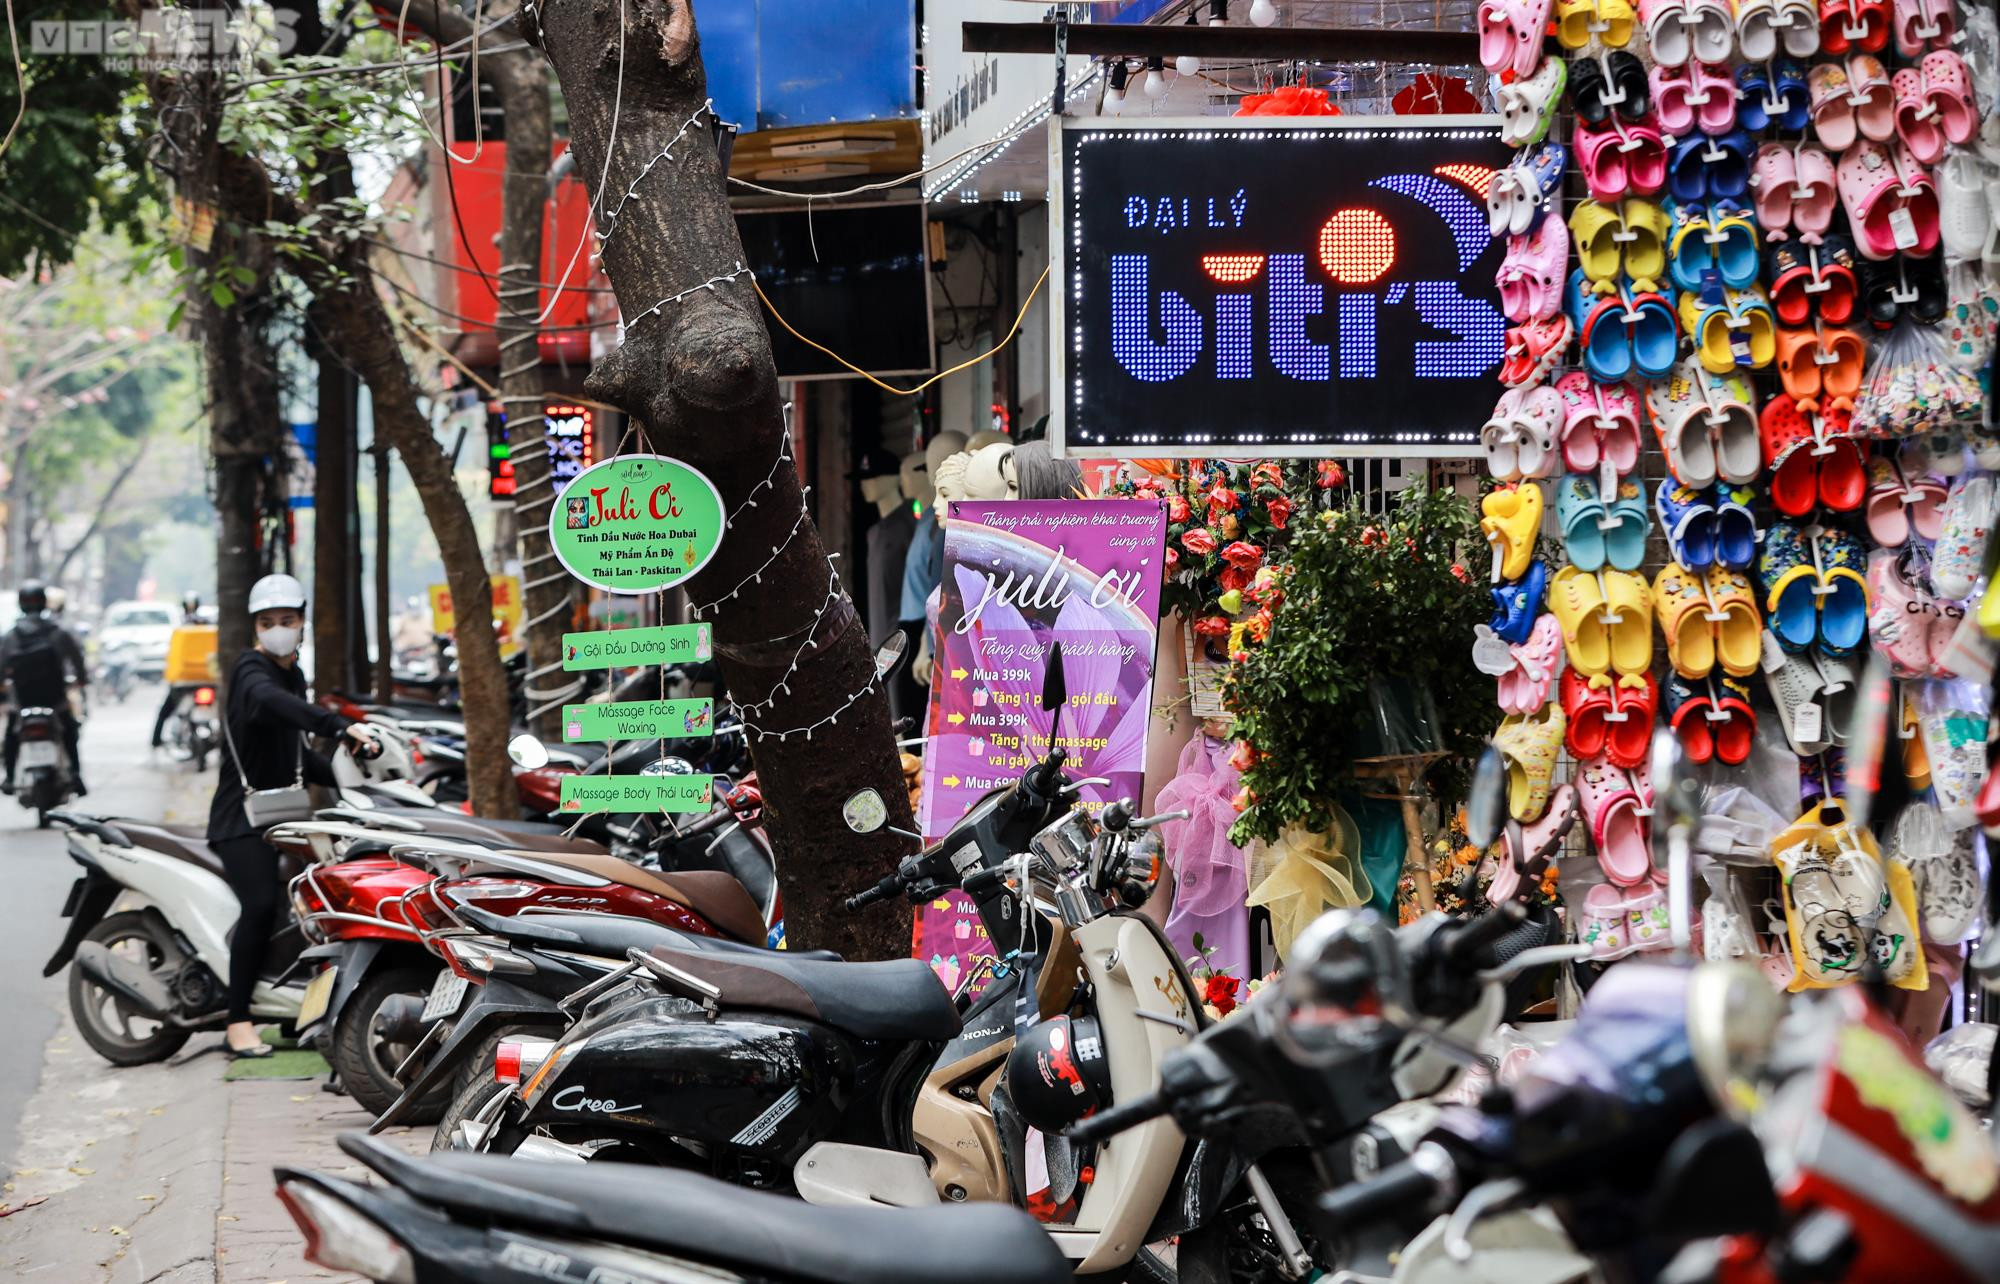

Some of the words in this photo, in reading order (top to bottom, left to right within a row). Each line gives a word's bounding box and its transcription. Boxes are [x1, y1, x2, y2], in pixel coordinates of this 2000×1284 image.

[1124, 197, 1188, 233] ĐẠI
[1208, 188, 1246, 227] LÝ
[590, 487, 641, 526] Juli
[982, 512, 1018, 532] Tháng
[1044, 513, 1088, 531] nghiệm
[1091, 512, 1118, 526] khai
[622, 531, 646, 541] Nước
[649, 531, 666, 540] Hoa
[669, 529, 697, 539] Dubai
[1110, 534, 1138, 552] cùng
[600, 551, 613, 562] Mỹ
[645, 545, 658, 558] Ấn
[661, 548, 674, 560] Độ
[592, 568, 613, 577] Thái
[616, 567, 632, 577] Lan
[641, 565, 681, 576] Paskitan
[954, 545, 1074, 635] juli
[584, 643, 601, 658] Gội
[631, 641, 665, 654] Dưỡng
[670, 638, 690, 650] Sinh
[978, 636, 1016, 664] Tặng
[1050, 638, 1096, 657] hách
[1097, 639, 1137, 664] hàng
[973, 669, 998, 681] Mua
[1002, 668, 1031, 681] 399k
[991, 691, 1021, 707] Tặng
[1024, 692, 1030, 704] 1
[1072, 692, 1091, 708] gội
[598, 706, 644, 719] Massage
[649, 704, 675, 715] Face
[970, 713, 996, 726] Mua
[999, 713, 1028, 726] 399k
[617, 721, 656, 735] Waxing
[990, 733, 1019, 750] Tặng
[1023, 735, 1028, 746] 1
[1055, 736, 1108, 750] massage
[989, 754, 1006, 766] vai
[1009, 754, 1030, 768] gáy
[965, 775, 991, 789] Mua
[573, 787, 619, 801] Massage
[624, 787, 651, 800] Body
[657, 786, 677, 798] Thái
[681, 787, 700, 798] Lan
